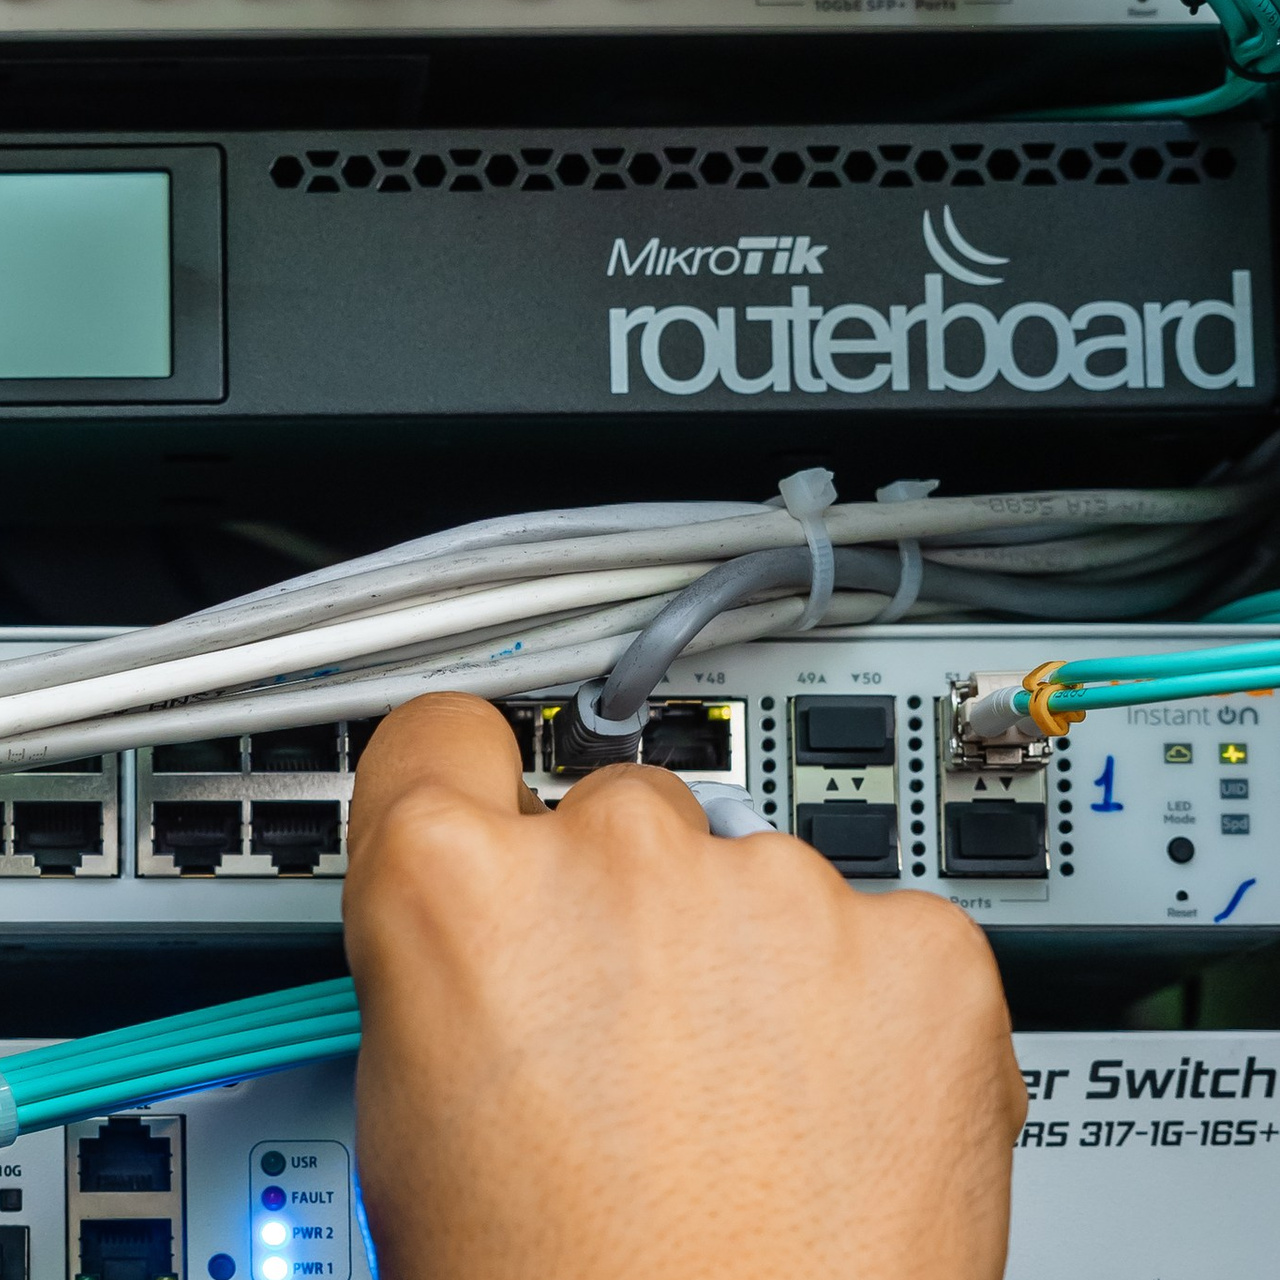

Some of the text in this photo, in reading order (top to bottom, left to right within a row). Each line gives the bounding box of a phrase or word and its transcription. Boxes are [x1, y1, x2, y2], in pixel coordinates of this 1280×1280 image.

[606, 234, 829, 277] MikroTik
[609, 269, 1256, 395] routerboard
[706, 673, 726, 685] 48
[797, 673, 816, 685] 49
[862, 673, 882, 685] 50
[1127, 705, 1210, 727] Instant
[1167, 800, 1192, 812] LED
[1163, 814, 1196, 825] Mode
[1167, 907, 1197, 919] Reset
[1086, 1056, 1278, 1100] Switch
[1012, 1120, 1280, 1148] RS 317-1G-16S+
[291, 1155, 318, 1169] USR
[291, 1191, 334, 1205] FAULT
[292, 1226, 334, 1240] PWR 2
[293, 1261, 334, 1276] PWR 1
